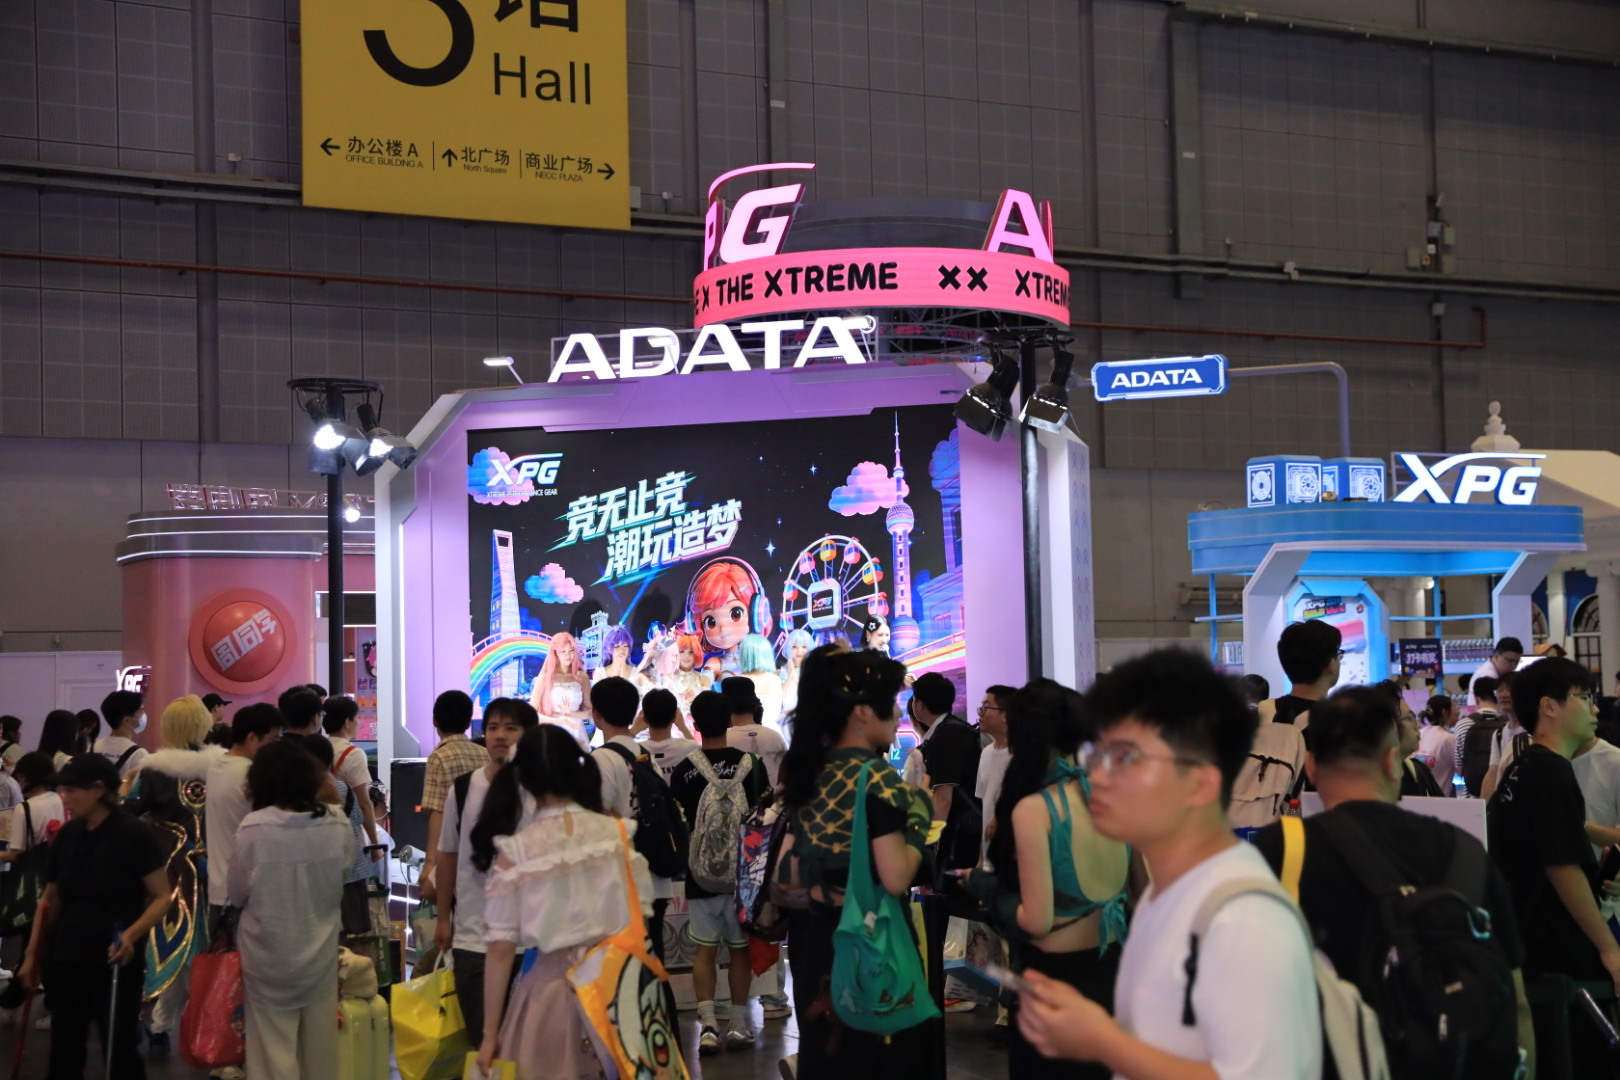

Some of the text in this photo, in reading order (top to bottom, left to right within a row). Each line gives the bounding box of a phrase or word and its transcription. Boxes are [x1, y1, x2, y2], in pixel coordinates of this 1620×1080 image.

[493, 52, 591, 105] Hall
[345, 153, 424, 169] OFFICE BUILDING A
[460, 146, 510, 167] 北广场
[525, 152, 593, 174] 商业广场
[463, 163, 507, 175] North Square
[535, 171, 584, 183] NECC PLAZA
[716, 272, 754, 306] THE
[764, 261, 898, 299] XTREME
[547, 316, 868, 383] ADATA
[1111, 368, 1203, 389] ADATA
[486, 453, 564, 487] XPG
[1393, 452, 1547, 506] XPG
[544, 488, 558, 496] GEAR
[603, 498, 743, 578] 潮玩造梦
